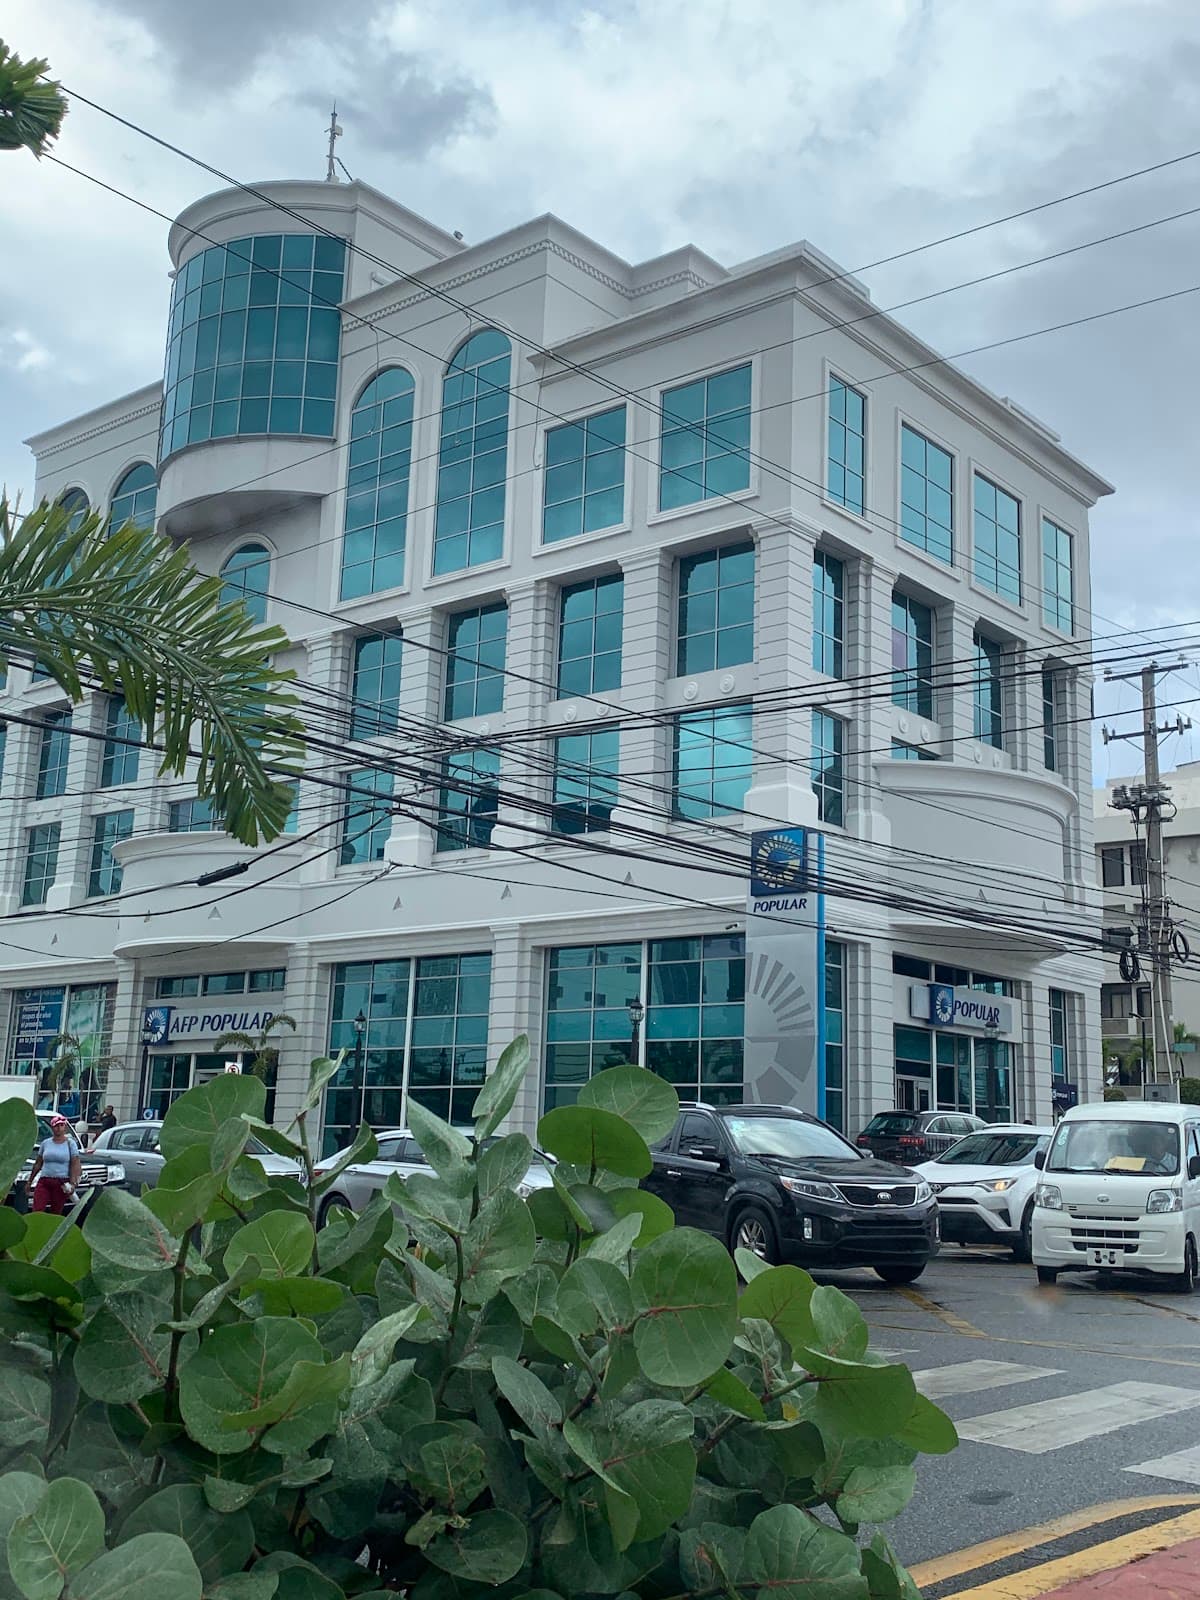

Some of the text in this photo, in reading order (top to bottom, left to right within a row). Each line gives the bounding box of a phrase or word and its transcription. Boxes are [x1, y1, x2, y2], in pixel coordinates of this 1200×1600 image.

[753, 898, 807, 912] POPULAR
[952, 1000, 1000, 1023] POPULAR
[170, 1012, 273, 1033] AFP POPULAR
